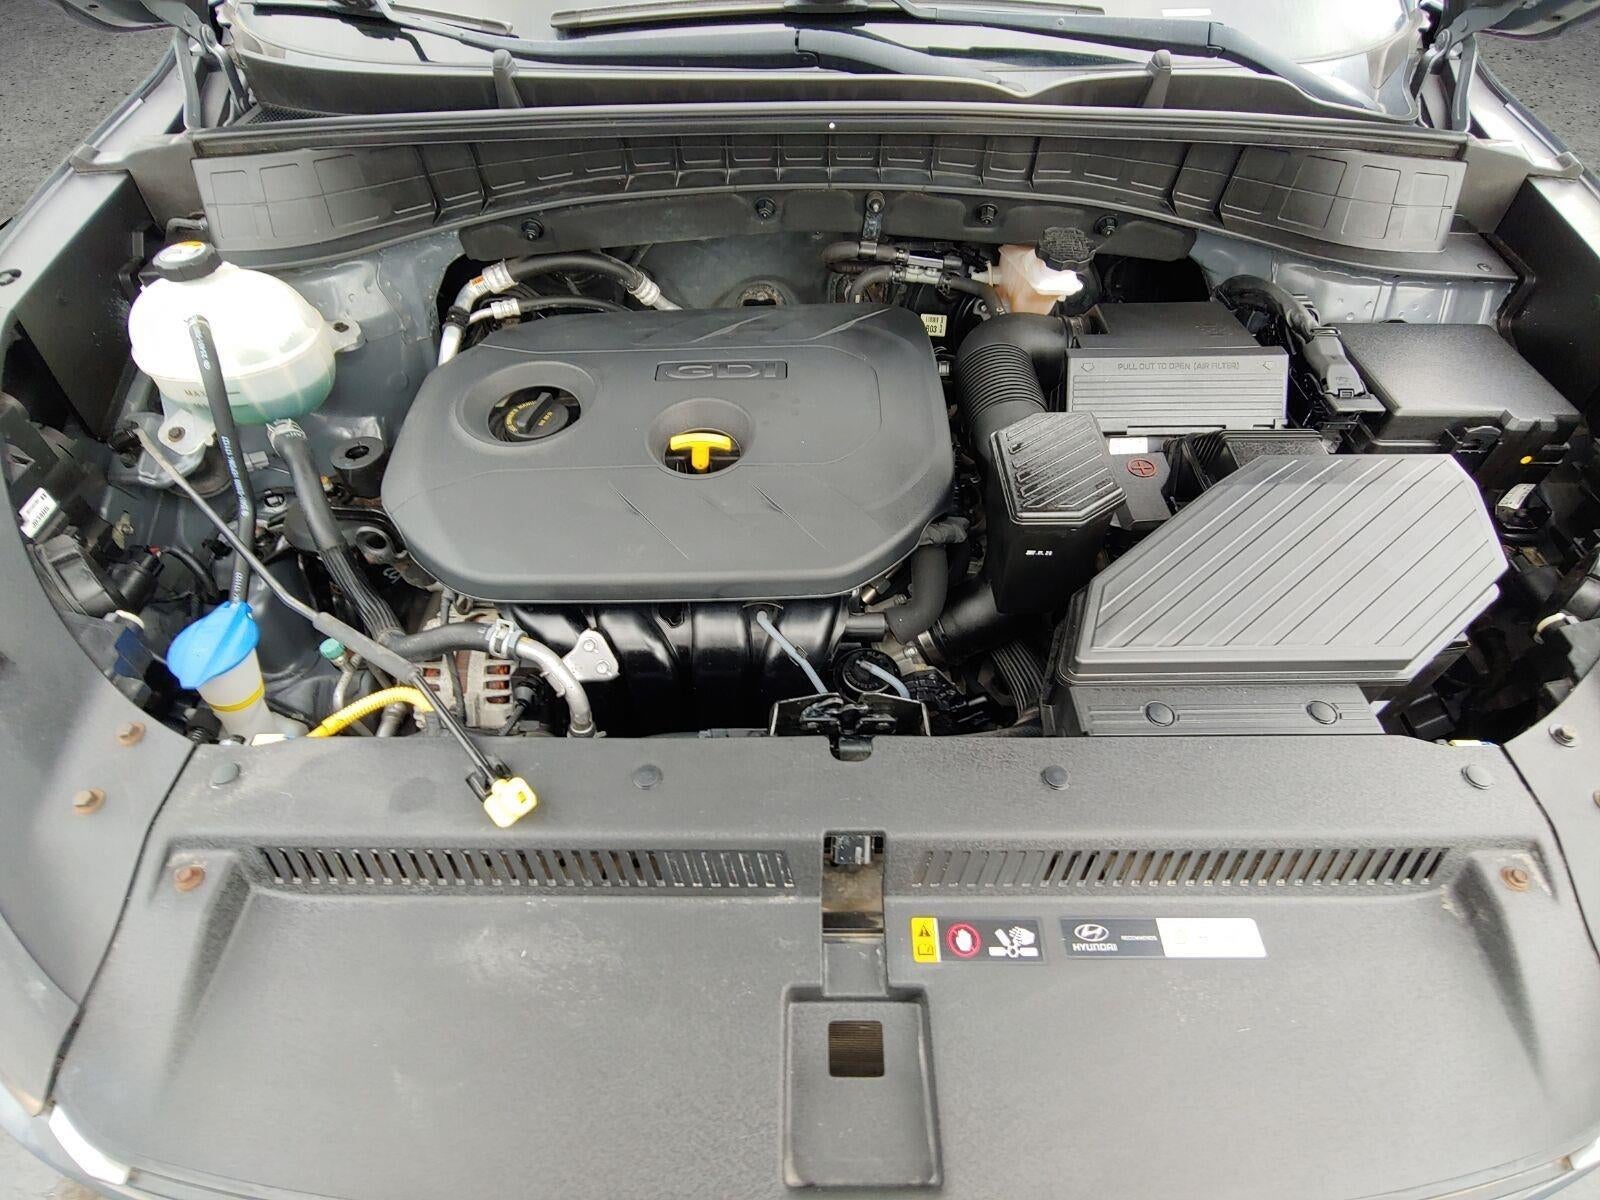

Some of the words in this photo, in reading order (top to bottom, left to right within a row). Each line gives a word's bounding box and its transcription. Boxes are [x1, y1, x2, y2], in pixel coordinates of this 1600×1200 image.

[665, 363, 776, 379] GDI
[1140, 362, 1155, 370] OUT
[1157, 362, 1167, 370] TO
[1169, 362, 1191, 370] OPEN
[1193, 361, 1209, 371] (AIR
[1211, 361, 1240, 370] FILTER)
[1072, 943, 1118, 951] HYUNDAI
